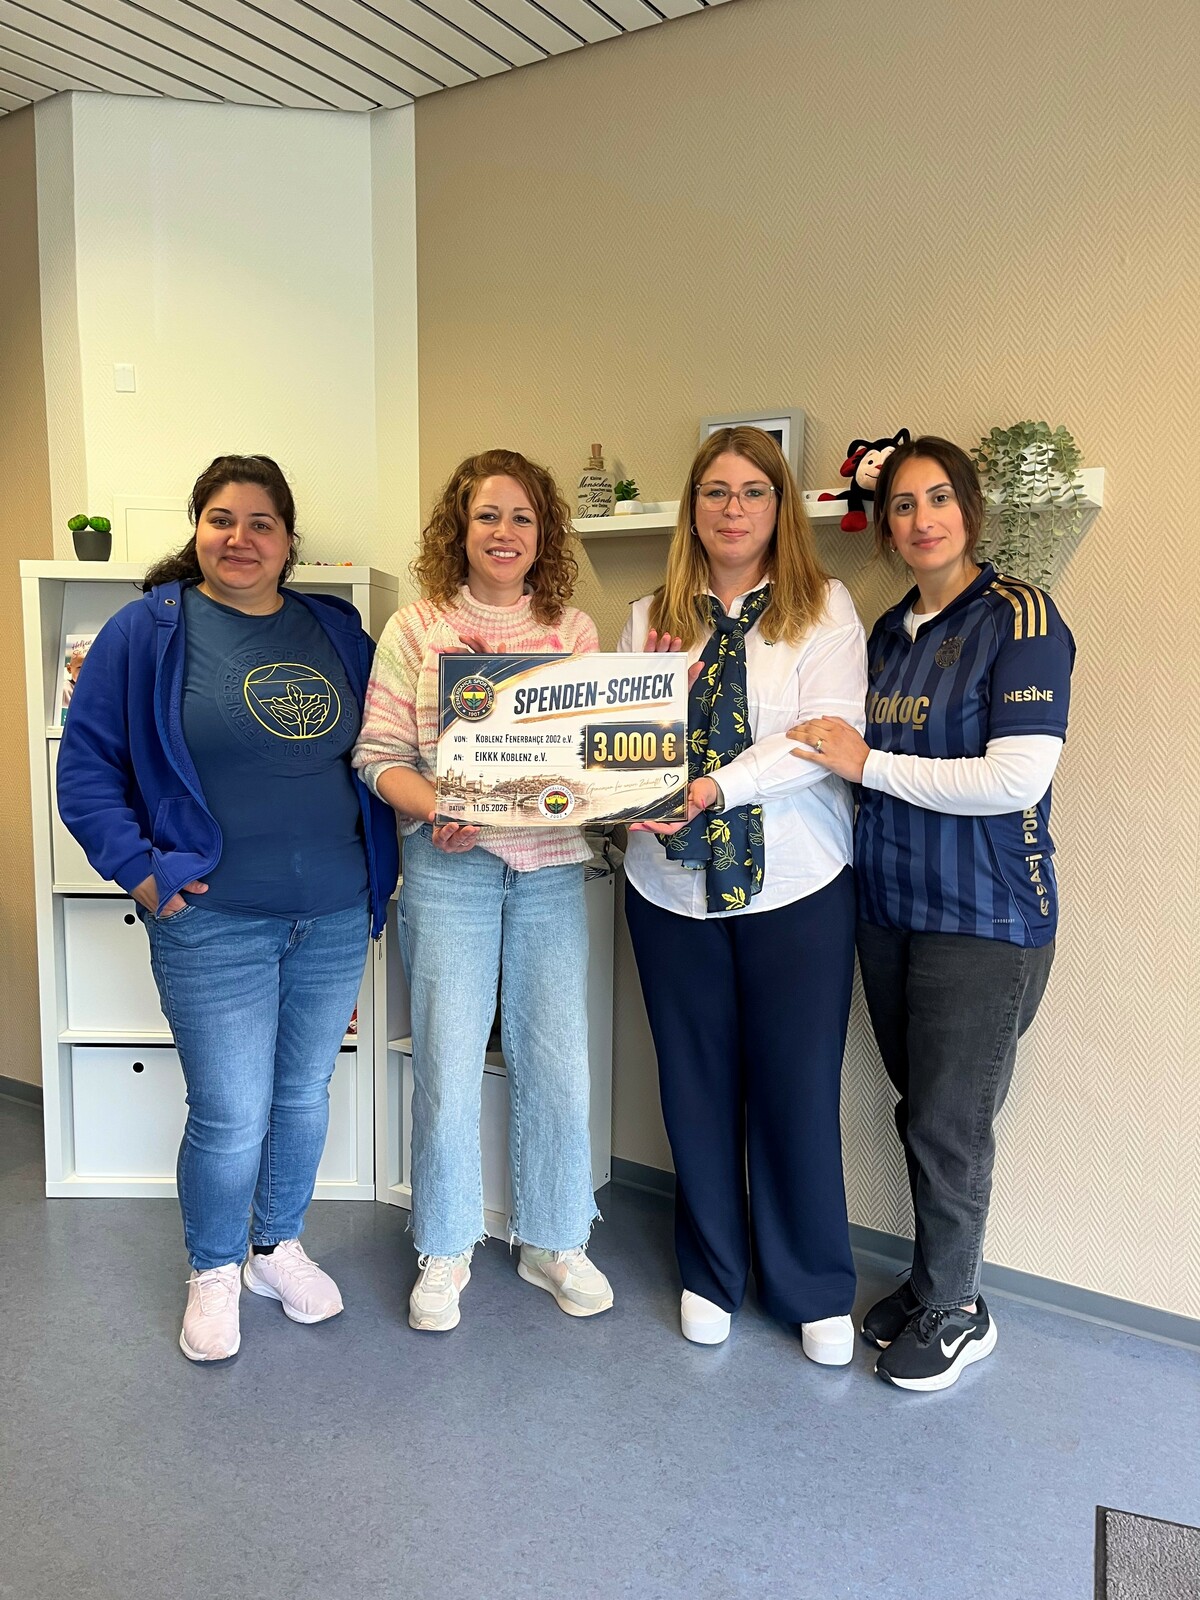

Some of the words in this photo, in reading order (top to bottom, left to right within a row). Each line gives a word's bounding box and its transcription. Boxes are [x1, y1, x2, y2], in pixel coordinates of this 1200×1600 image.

[272, 649, 321, 669] SPOR
[513, 672, 675, 715] SPENDEN-SCHECK
[867, 690, 930, 731] tokoç
[453, 735, 468, 743] VON:
[545, 734, 561, 744] 2002
[593, 731, 657, 762] 3.000
[661, 732, 677, 762] €
[284, 741, 320, 756] 1907
[475, 752, 499, 762] EIKKK
[534, 752, 548, 762] e.V.
[472, 803, 508, 812] 11.05.2026
